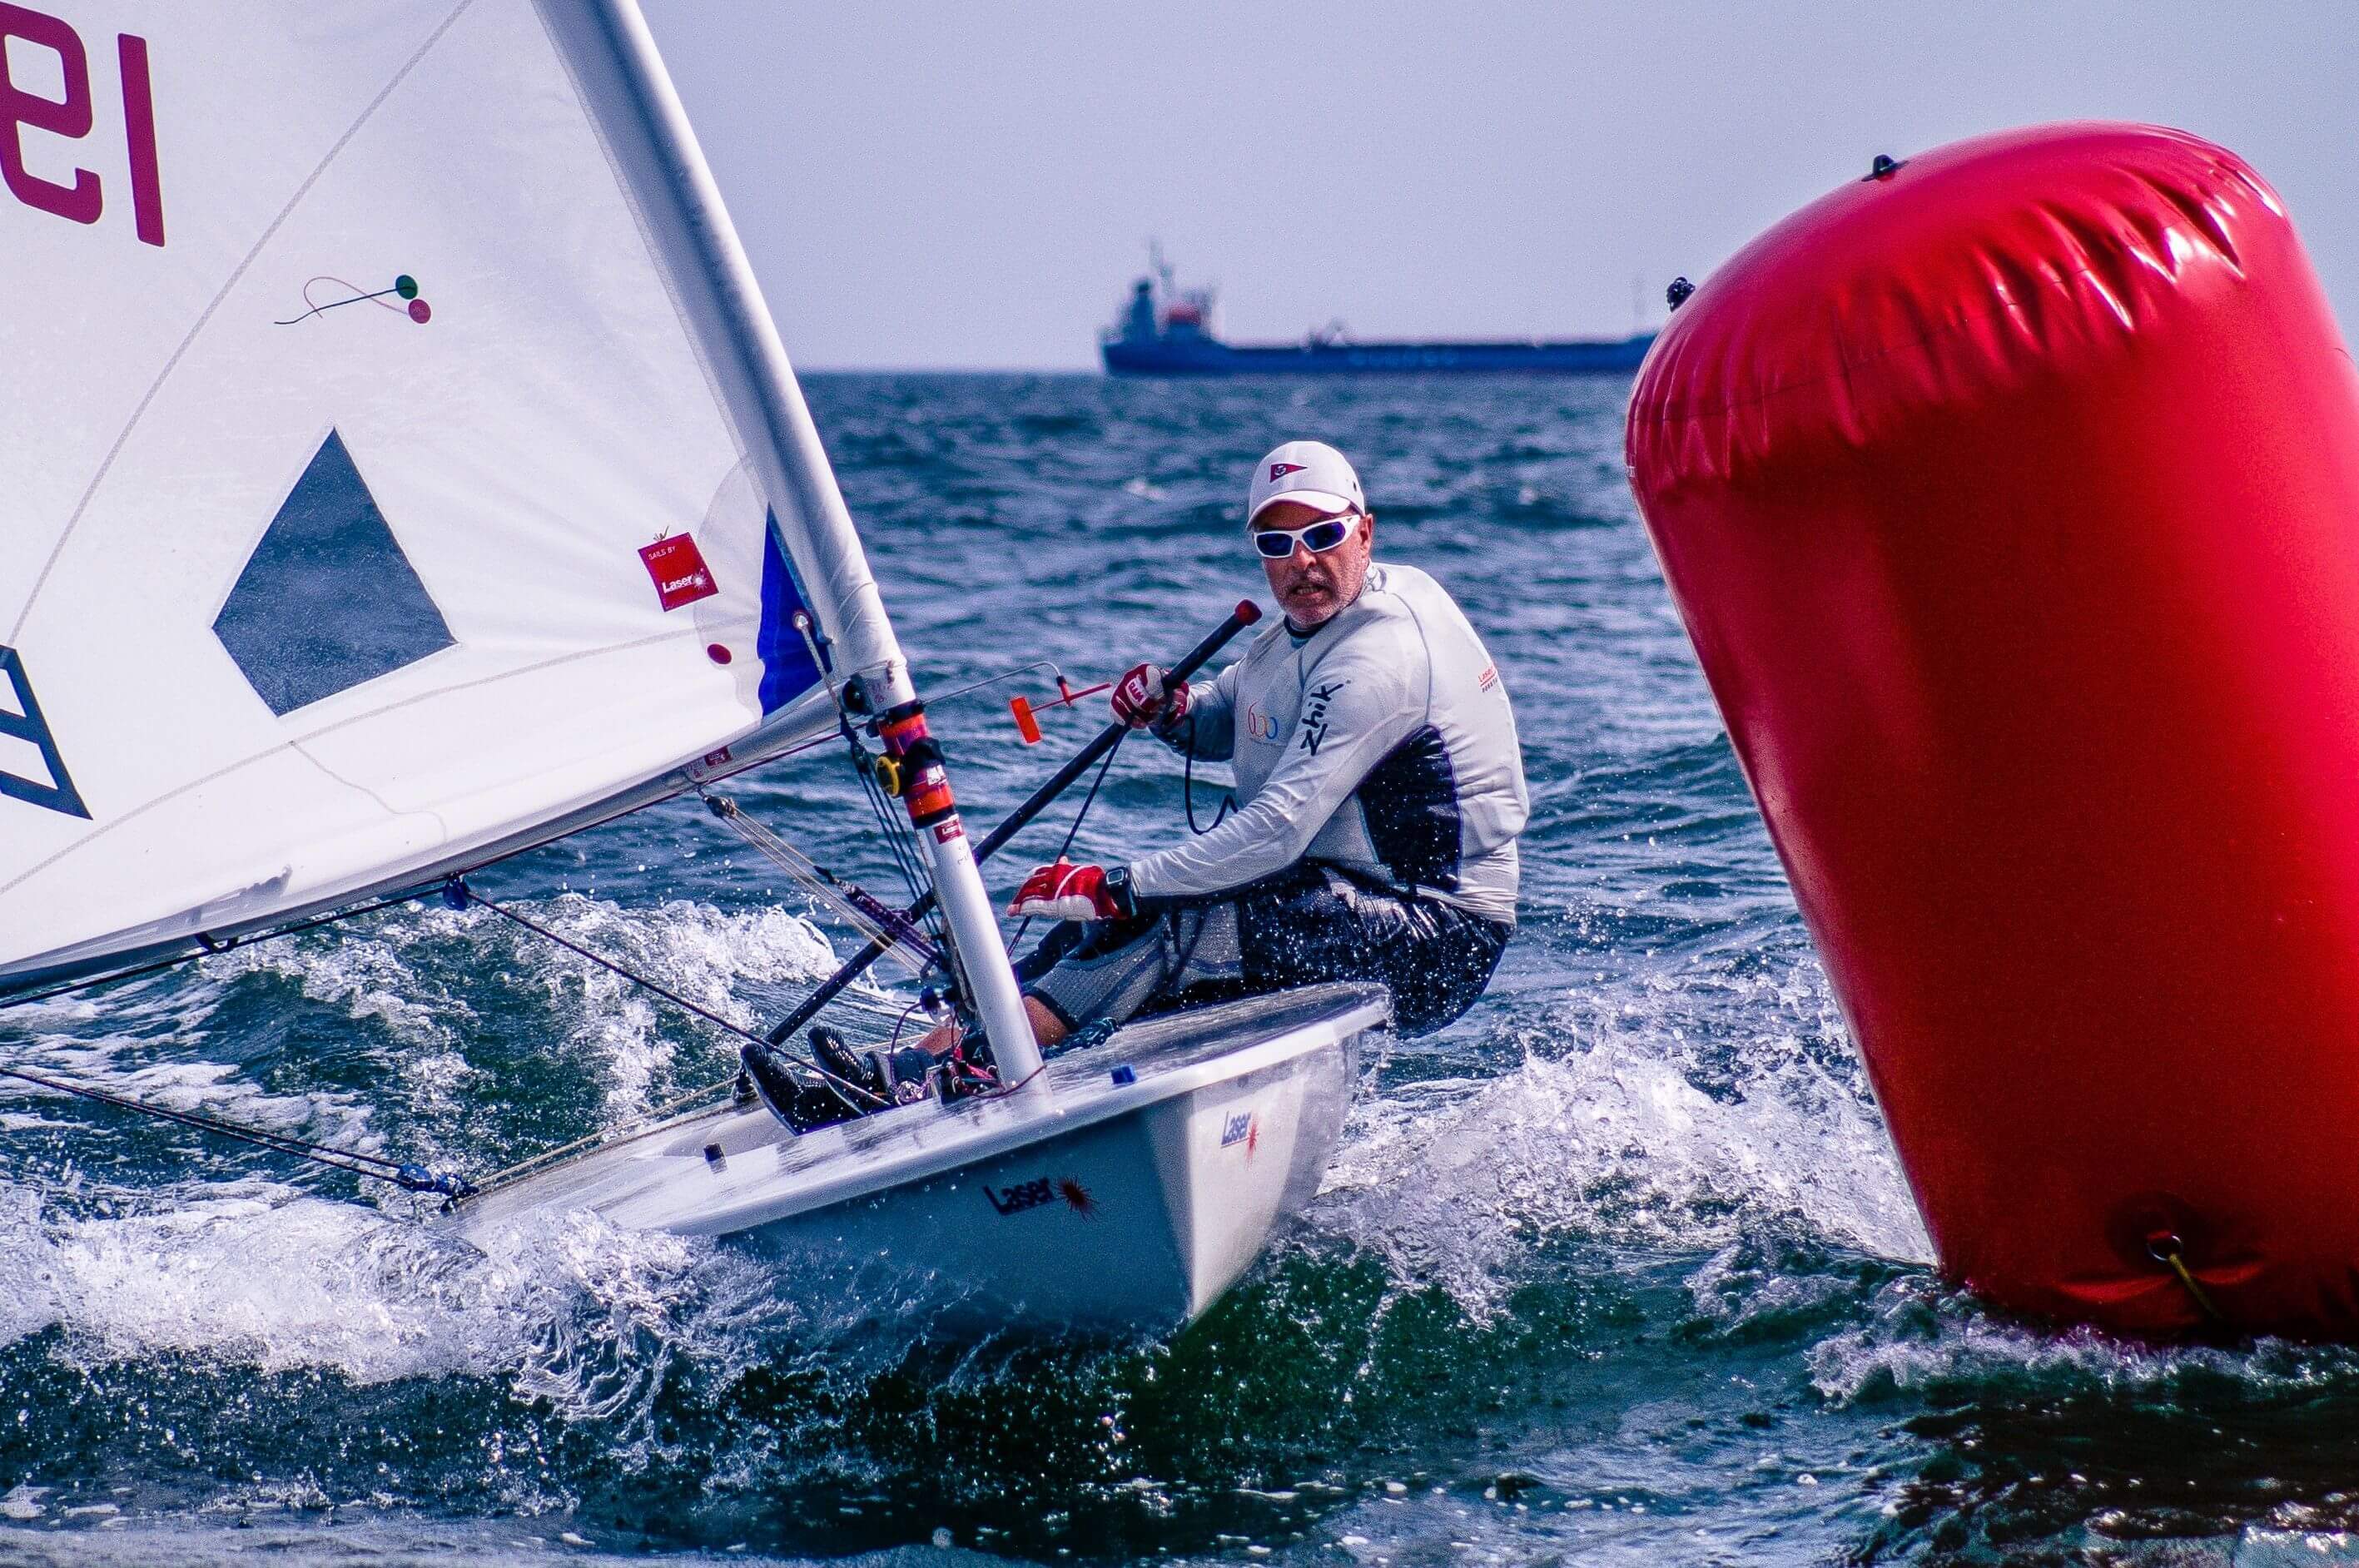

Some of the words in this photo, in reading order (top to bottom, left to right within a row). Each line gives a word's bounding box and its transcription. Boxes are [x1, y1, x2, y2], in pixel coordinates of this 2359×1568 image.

[667, 545, 676, 553] BY
[662, 573, 693, 594] Laser
[1300, 683, 1344, 757] Zhik
[1220, 1110, 1252, 1146] Laser
[983, 1177, 1055, 1216] Laser
